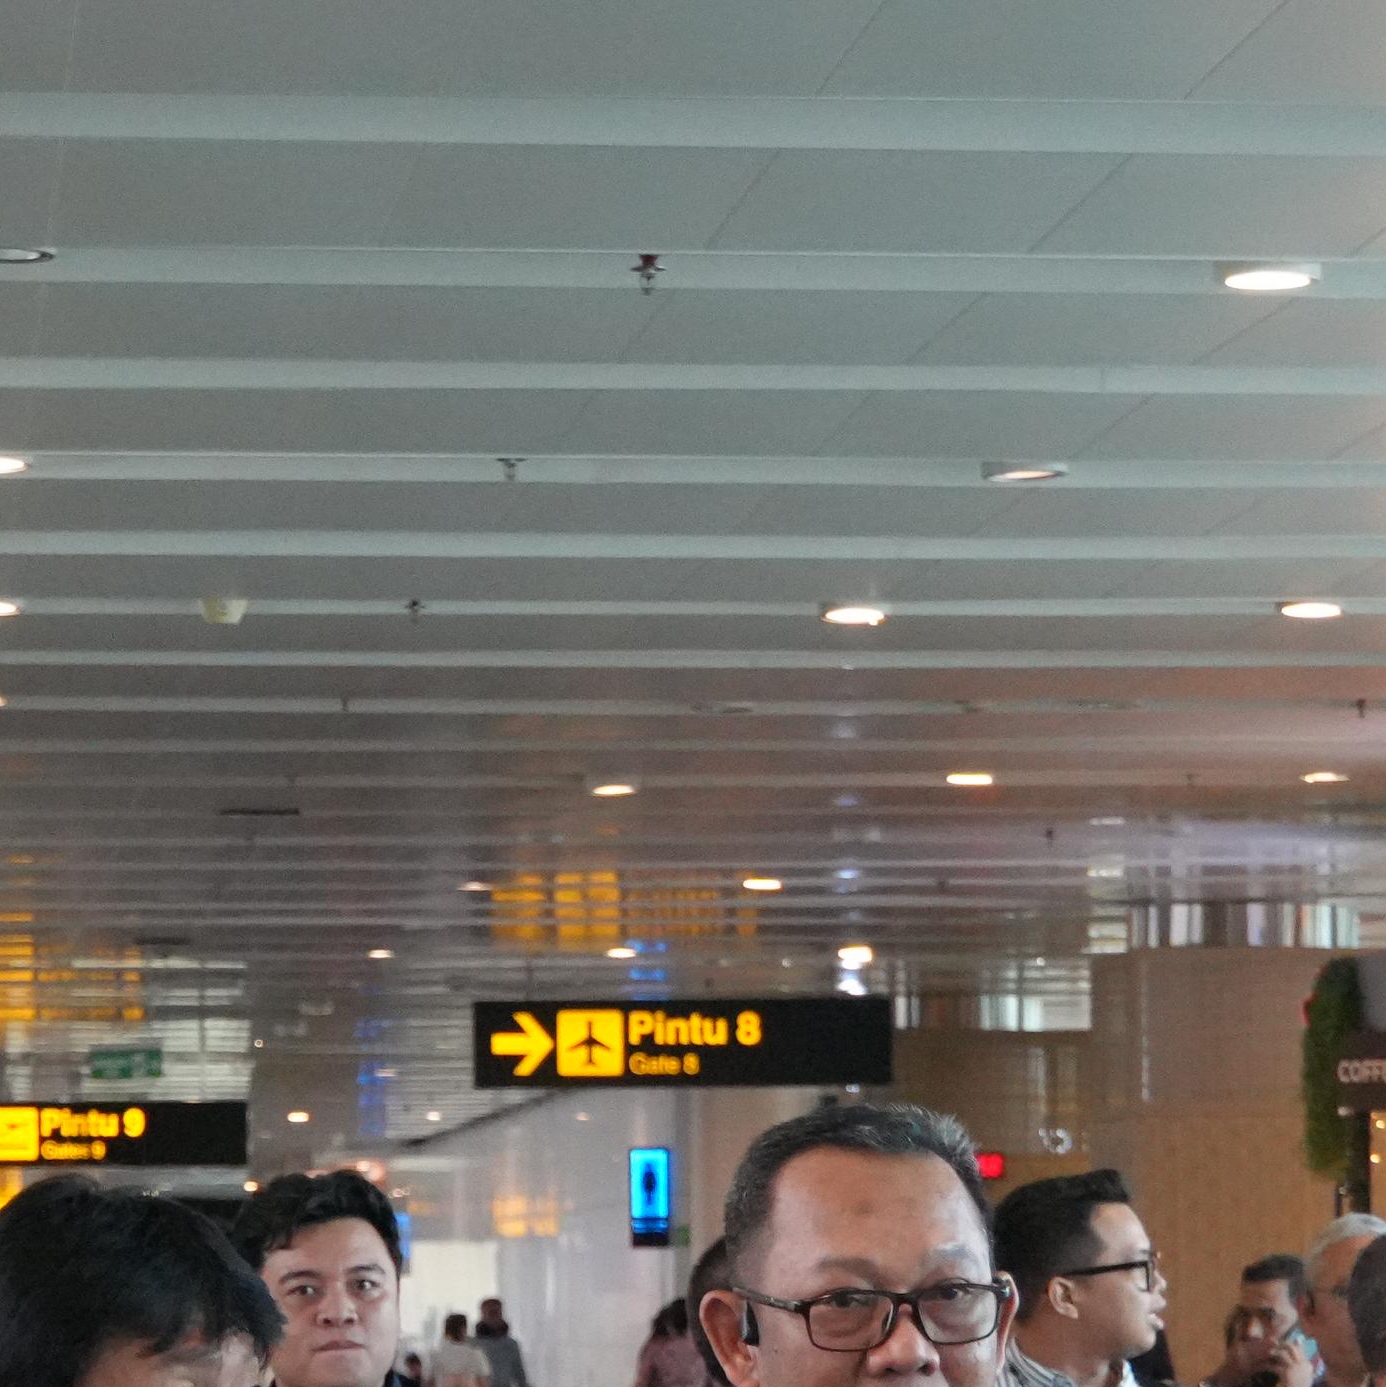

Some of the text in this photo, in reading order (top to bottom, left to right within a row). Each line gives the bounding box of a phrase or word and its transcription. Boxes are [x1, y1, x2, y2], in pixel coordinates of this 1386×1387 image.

[628, 1009, 762, 1046] Pintu 8
[628, 1051, 681, 1075] Gate
[40, 1107, 146, 1138] Pintu 9
